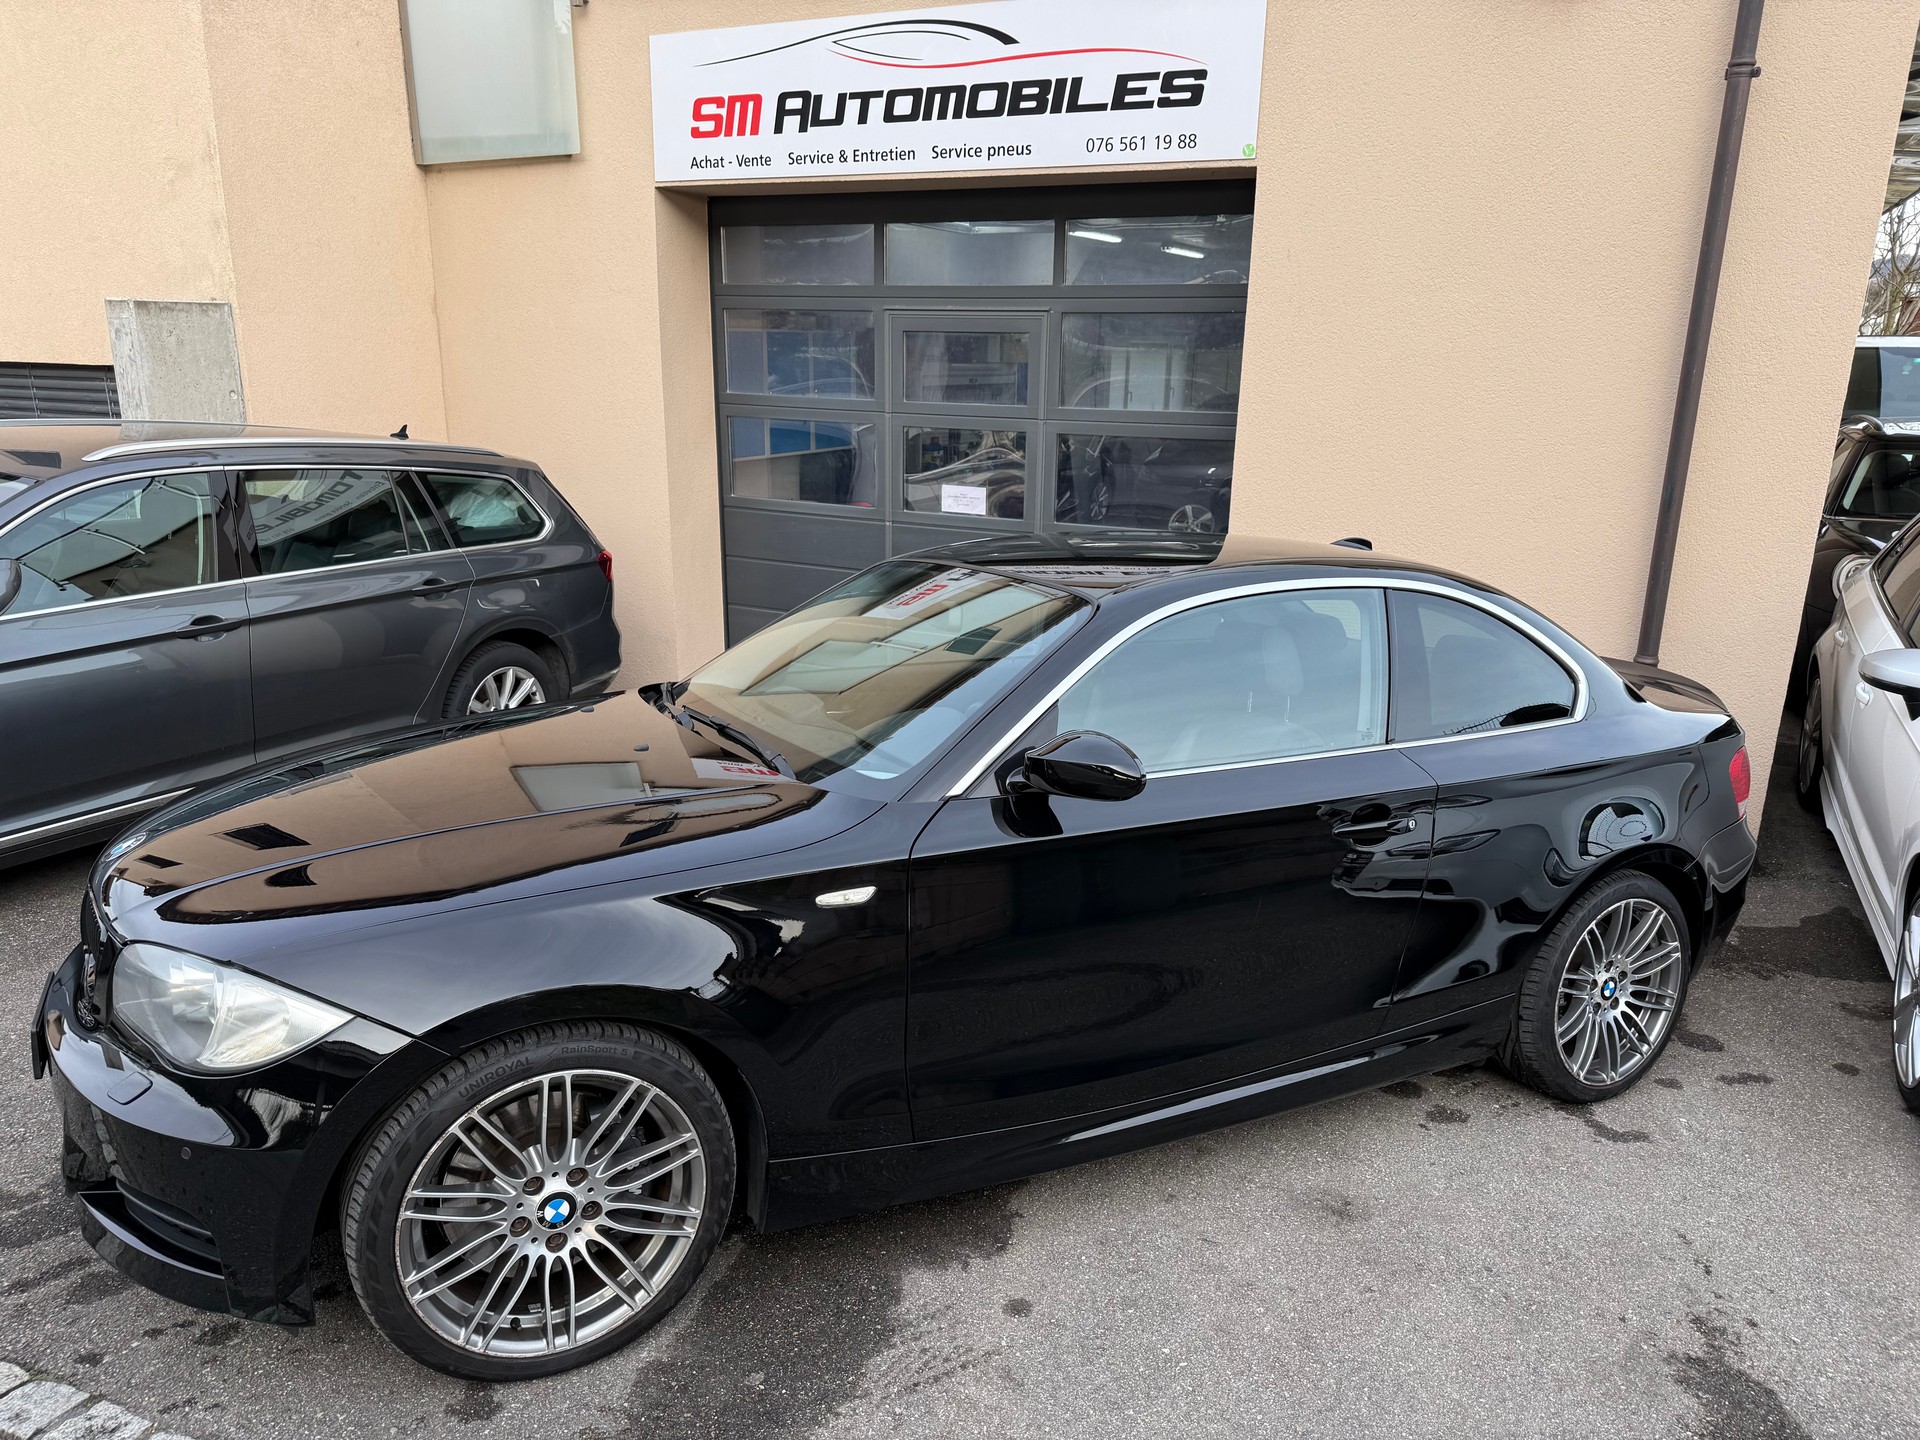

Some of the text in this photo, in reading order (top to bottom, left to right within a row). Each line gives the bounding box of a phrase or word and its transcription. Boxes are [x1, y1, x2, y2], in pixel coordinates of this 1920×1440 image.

[691, 68, 1209, 139] SM AUTOMOBILES
[932, 144, 1032, 161] Service pneus
[1087, 134, 1197, 153] 076 561 19 88
[691, 154, 725, 170] Achat
[736, 154, 772, 168] Vente
[789, 147, 915, 166] Service & Entretien
[561, 1045, 629, 1056] RainSport 5
[458, 1056, 537, 1099] UNIROYAL
